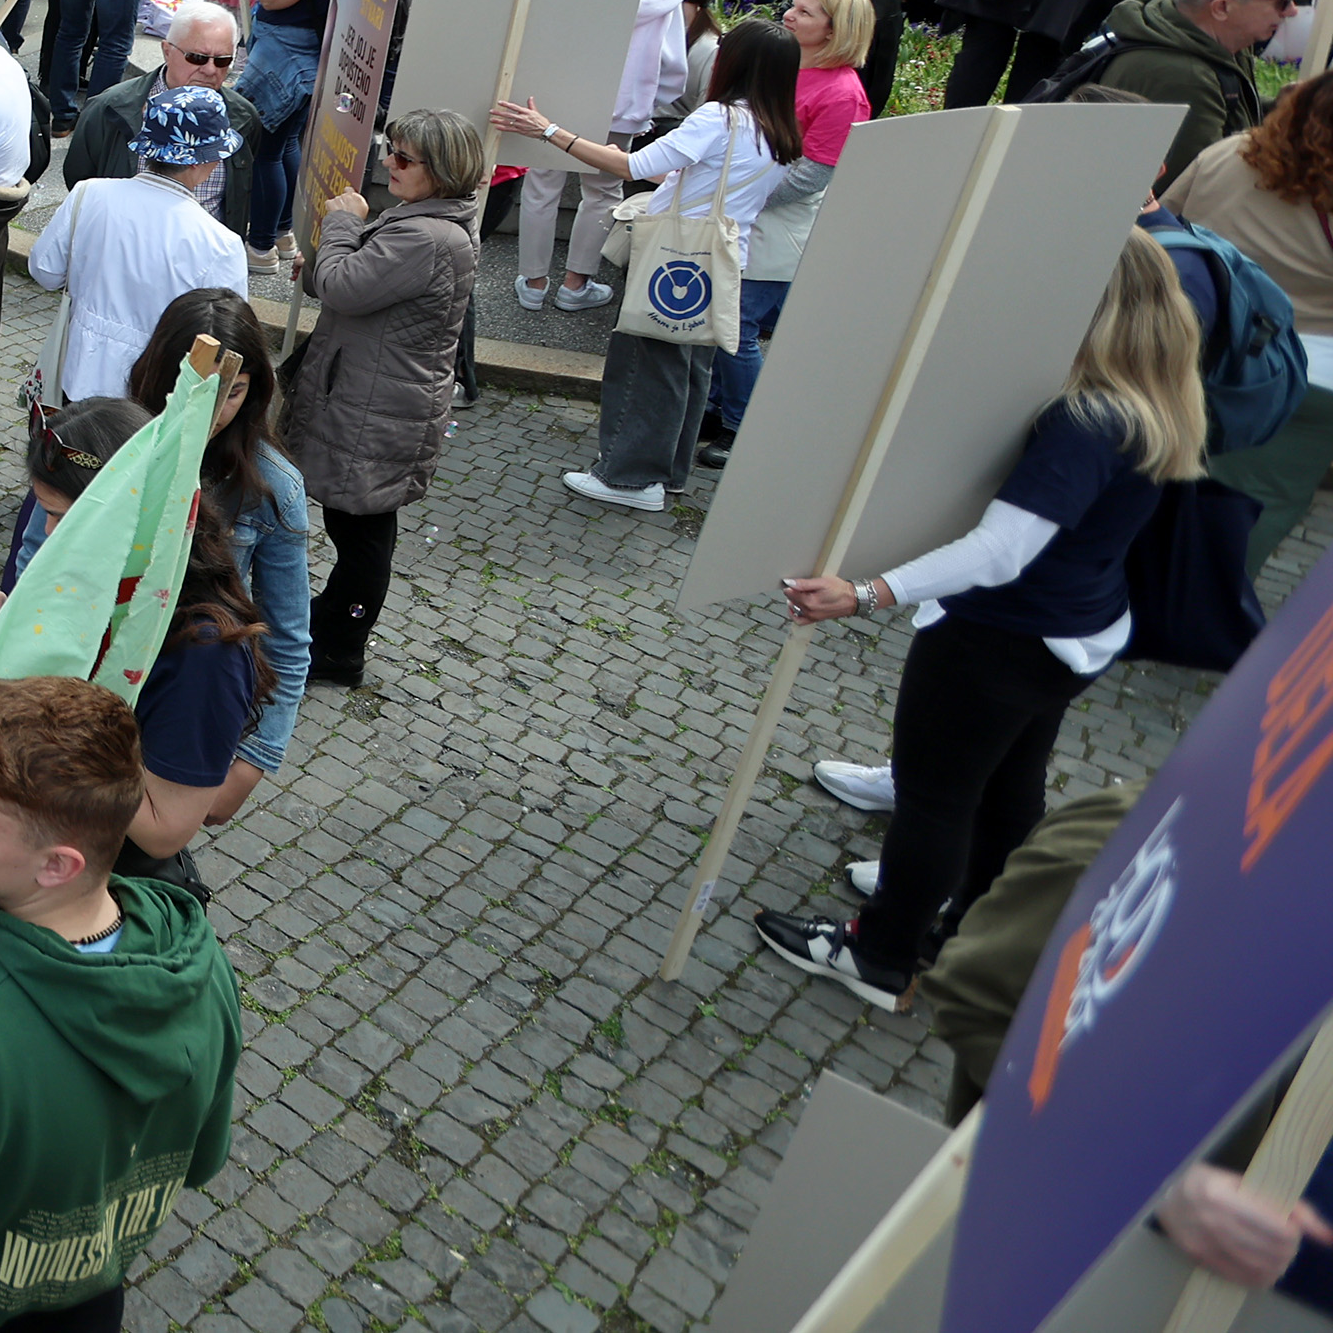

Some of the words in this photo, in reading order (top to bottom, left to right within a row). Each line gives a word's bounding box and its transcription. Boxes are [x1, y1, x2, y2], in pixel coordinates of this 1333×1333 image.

[338, 47, 371, 97] DOPUŠTENO
[365, 44, 377, 70] JE
[118, 1184, 161, 1242] THE
